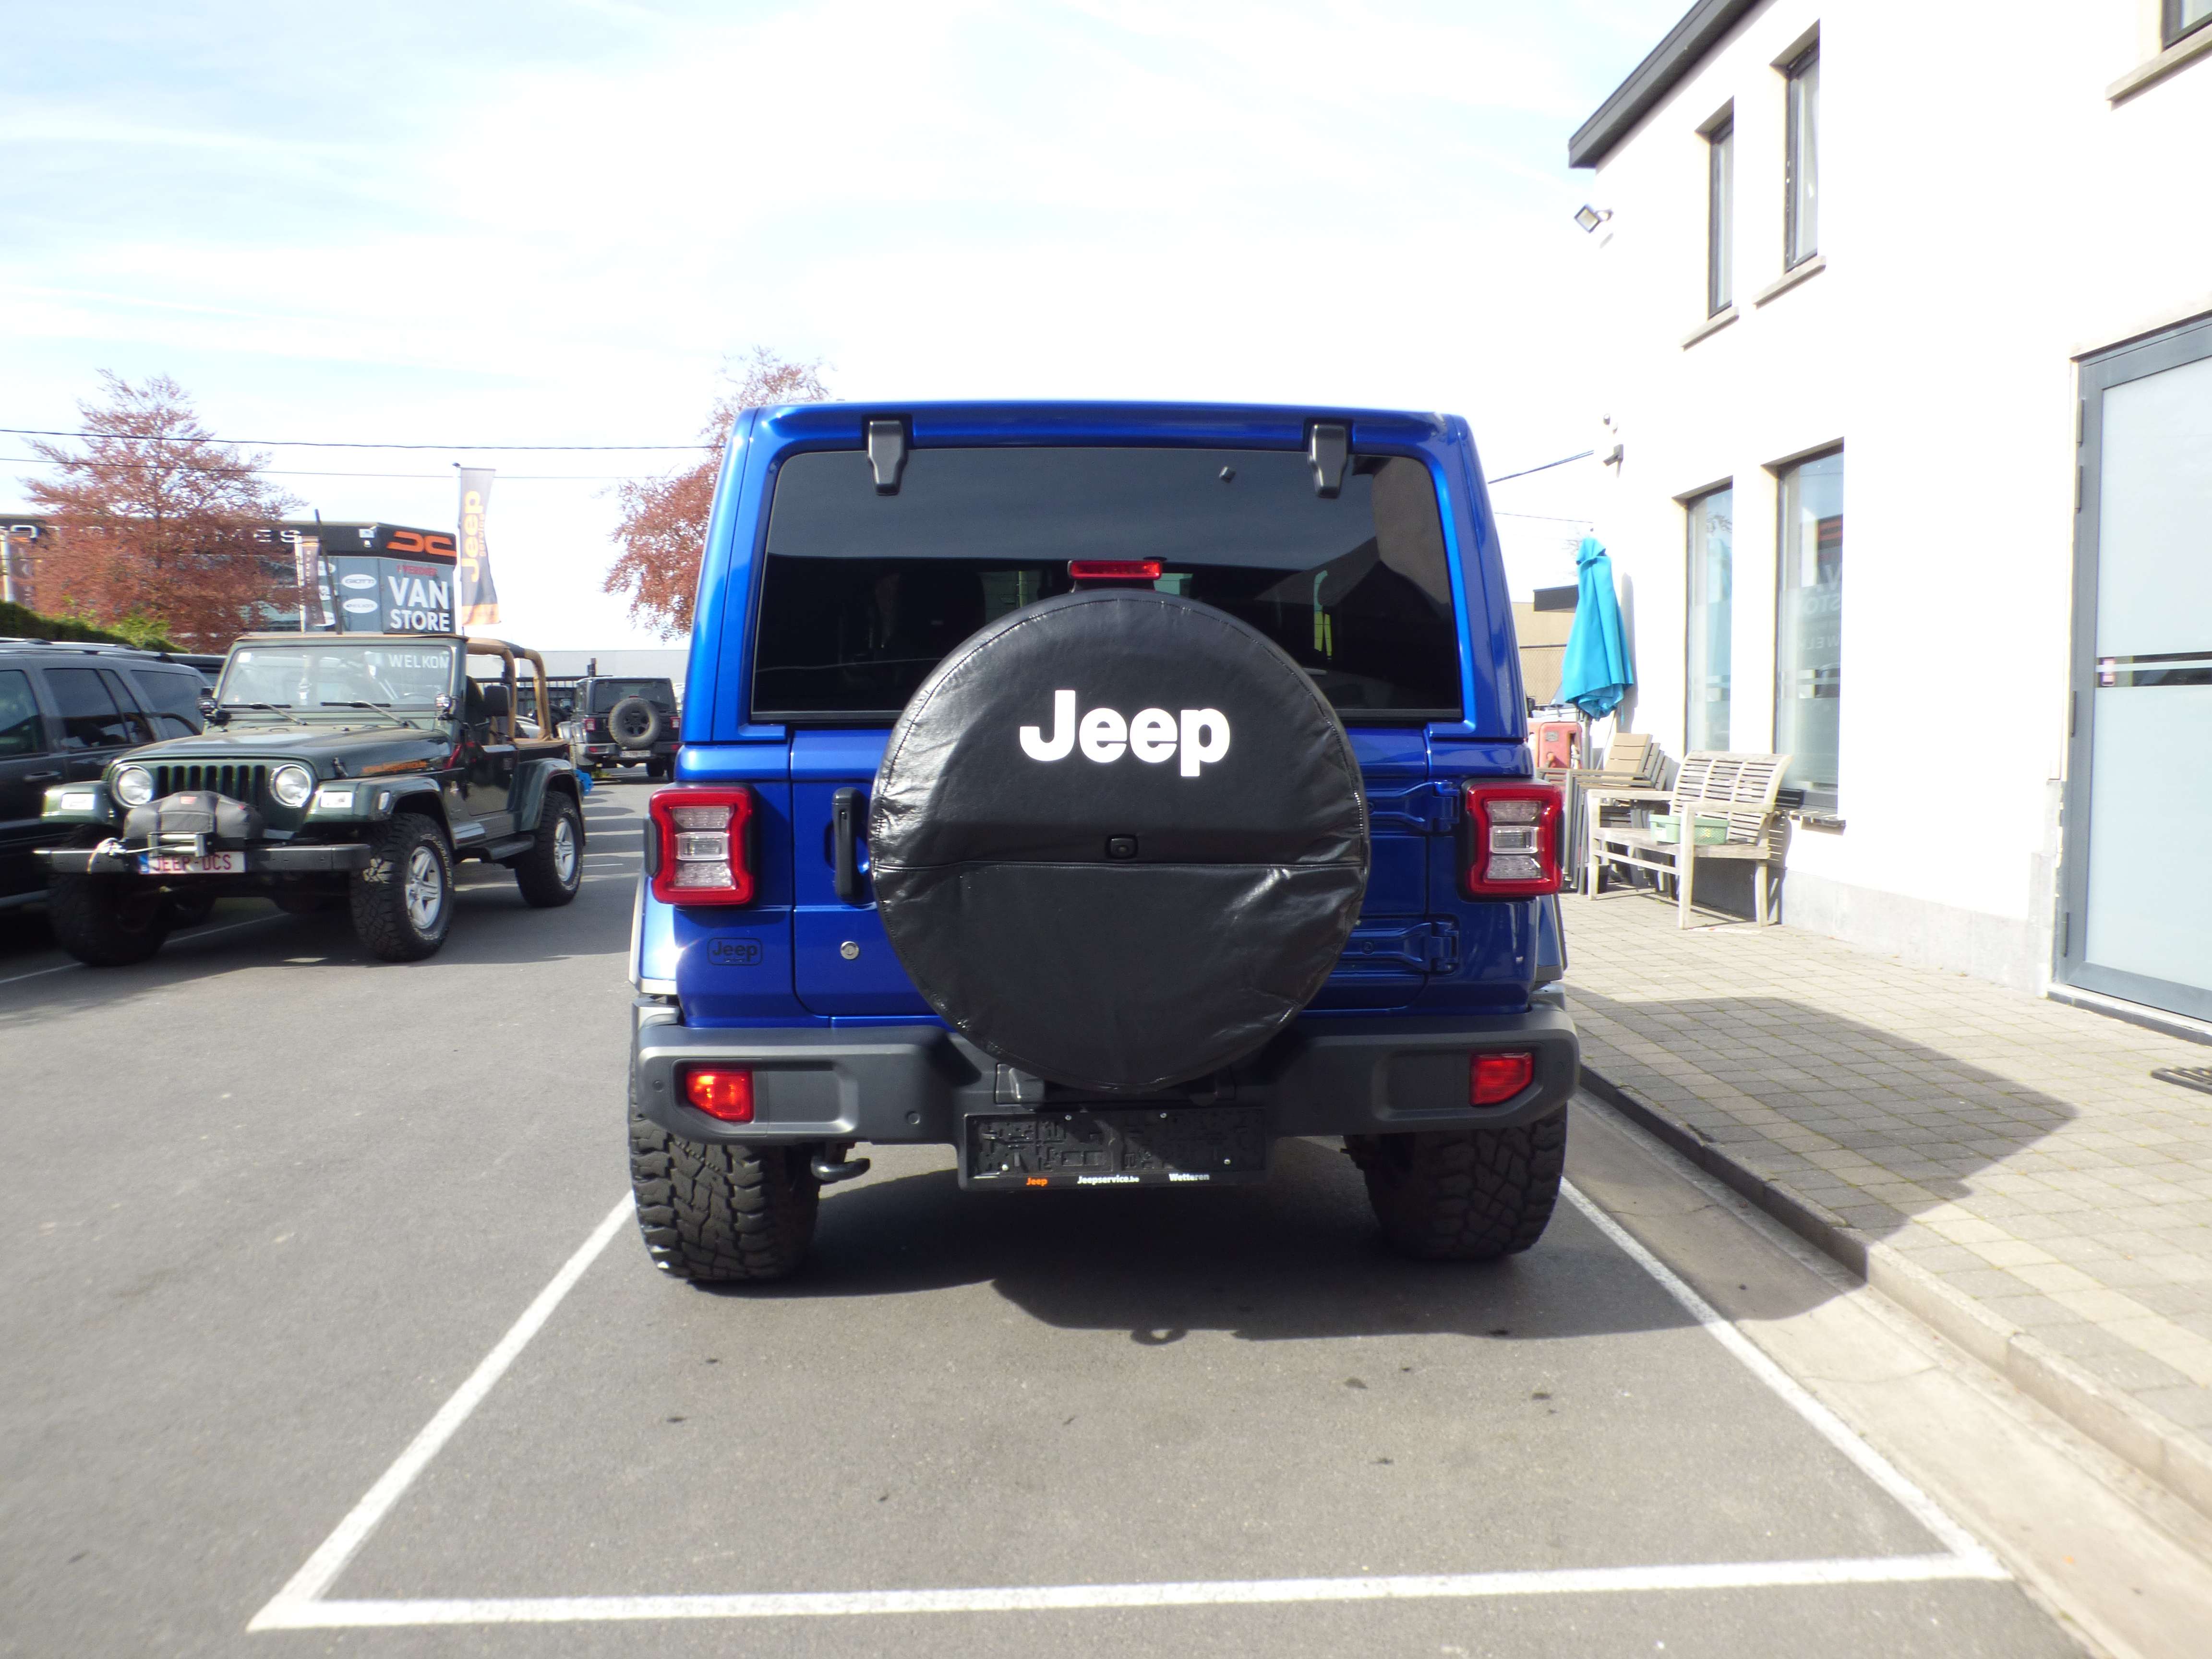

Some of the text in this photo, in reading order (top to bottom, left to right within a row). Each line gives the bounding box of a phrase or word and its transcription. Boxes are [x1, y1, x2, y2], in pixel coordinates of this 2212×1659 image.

[460, 490, 483, 583] Jeep
[387, 576, 450, 610] VAN
[390, 609, 450, 632] STORE
[1019, 689, 1230, 777] Jeep
[712, 941, 757, 962] Jeep
[1026, 1173, 1210, 1187] Jeep Jeepservice.be Wetteren
